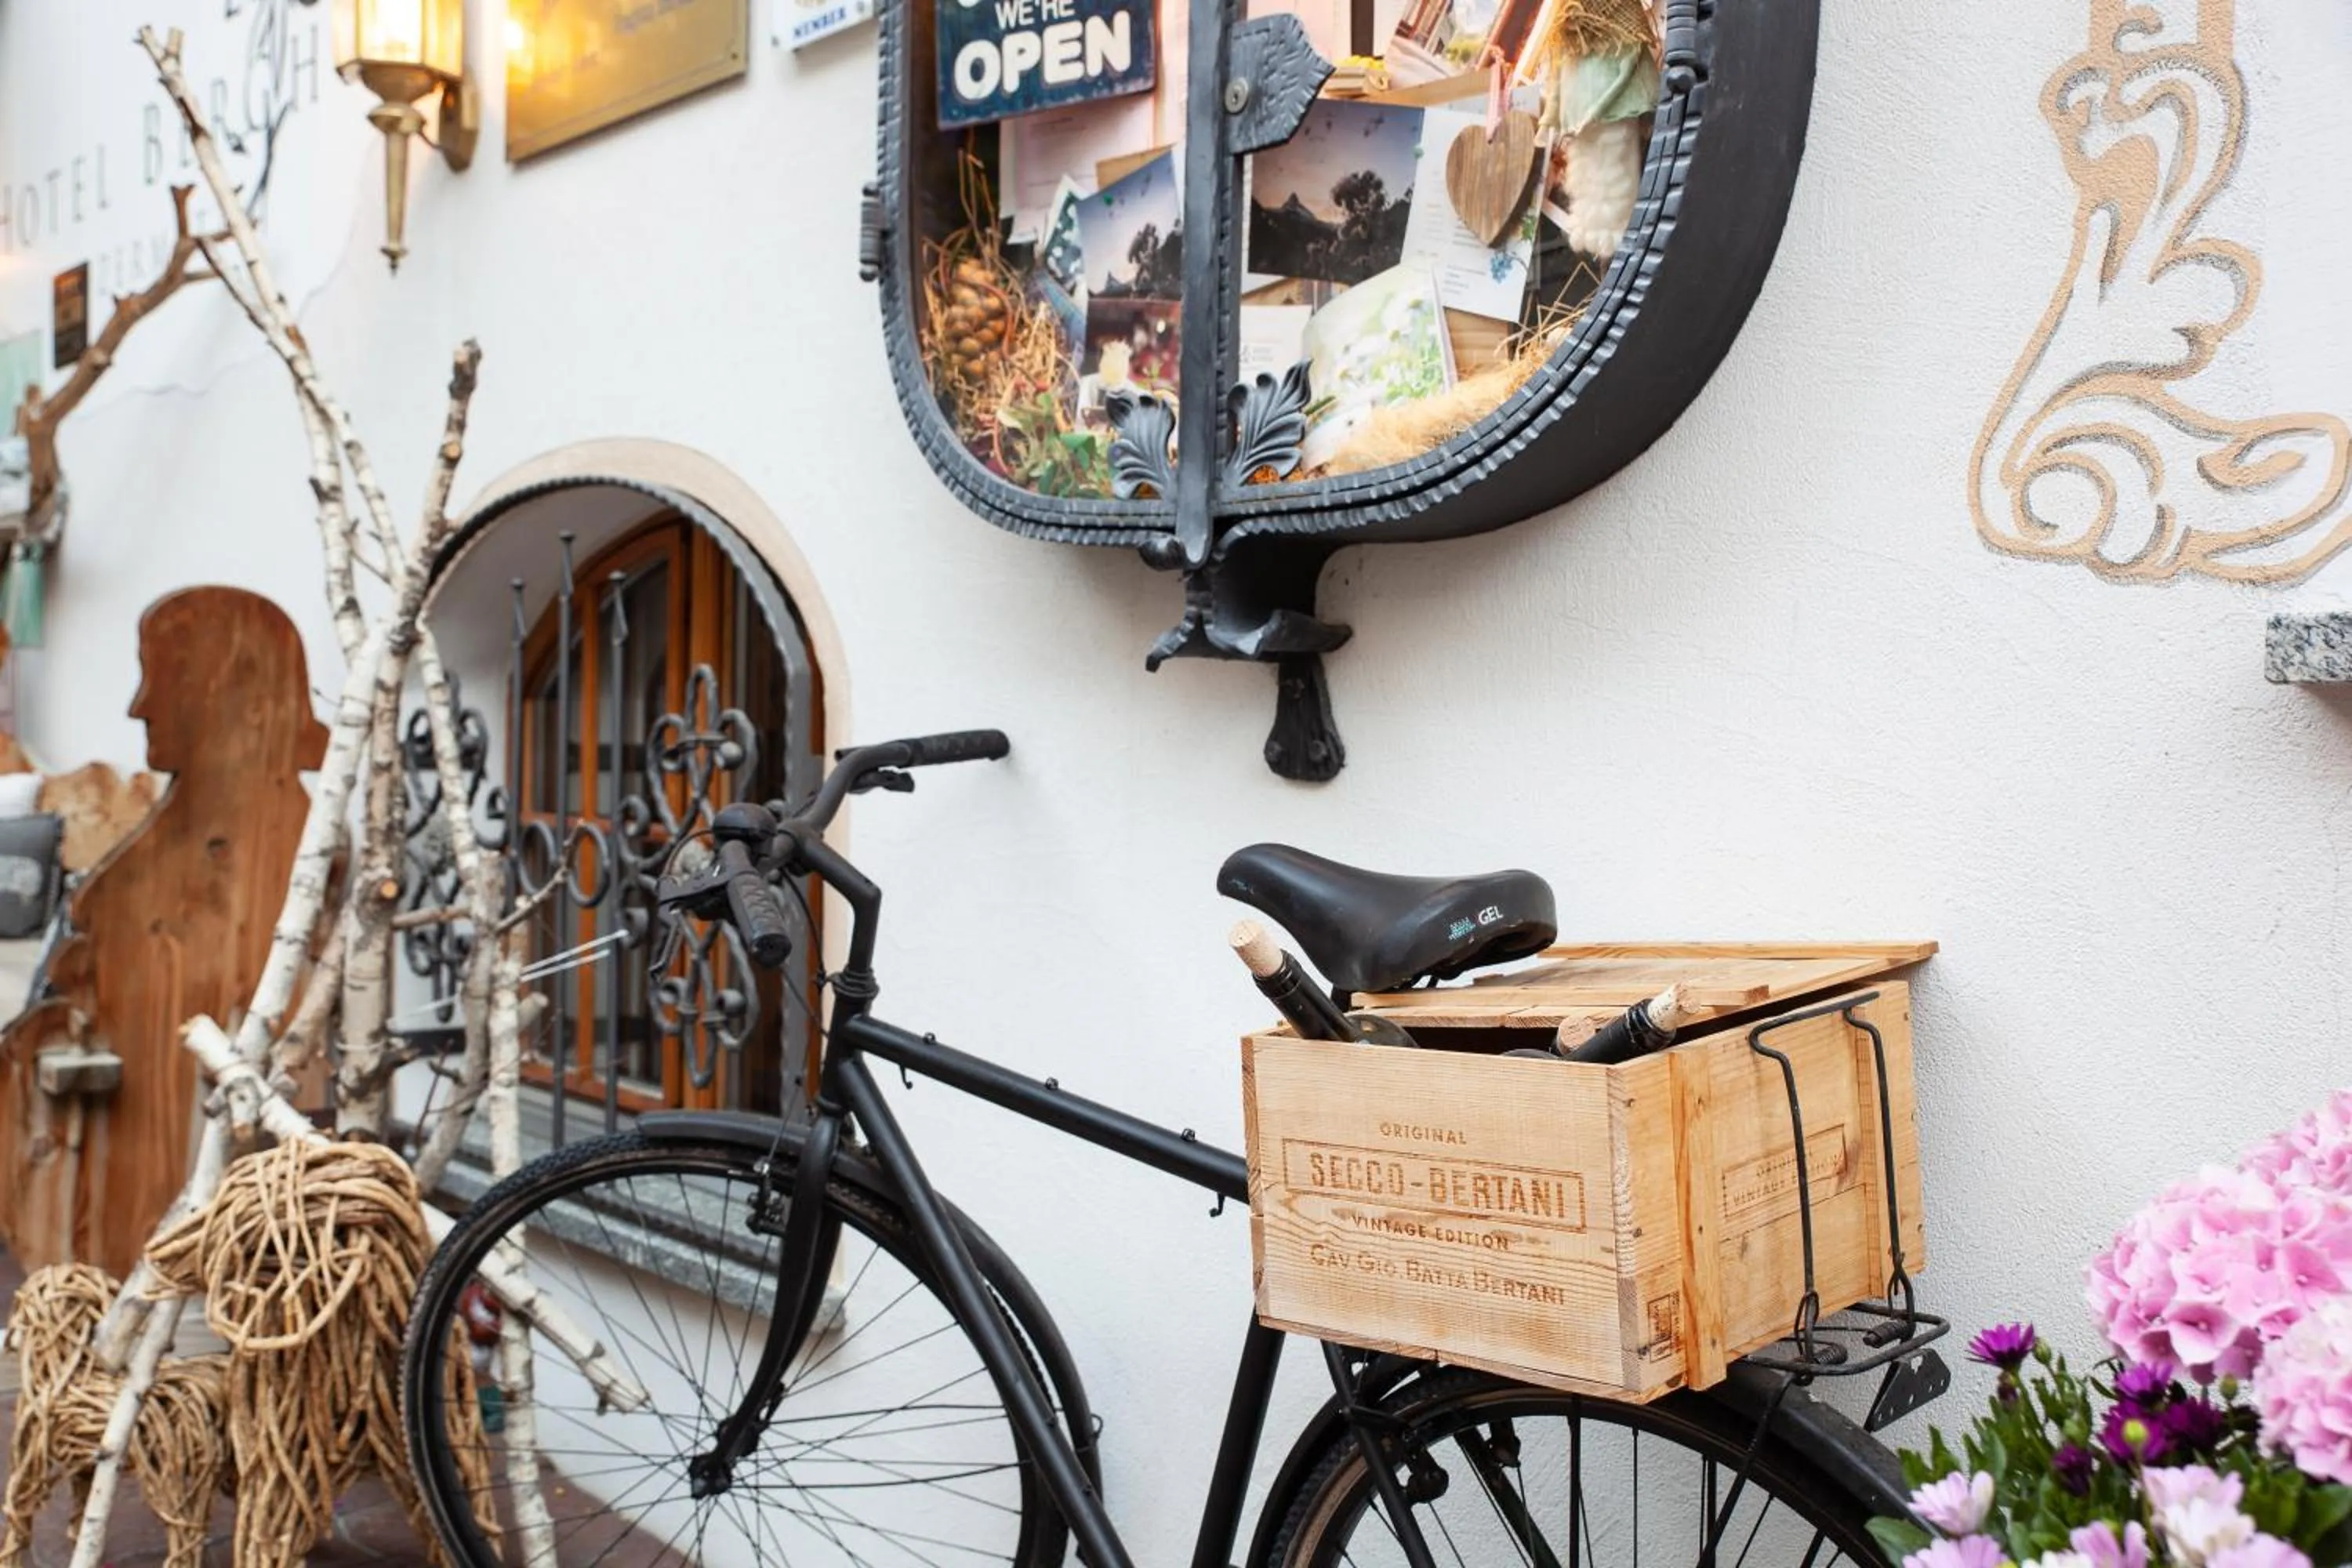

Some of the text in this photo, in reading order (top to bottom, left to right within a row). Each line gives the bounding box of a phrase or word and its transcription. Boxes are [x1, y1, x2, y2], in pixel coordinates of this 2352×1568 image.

[994, 0, 1076, 30] WE'RE
[954, 10, 1131, 100] OPEN
[0, 143, 109, 256] HOTEL
[1478, 906, 1504, 926] GEL
[1380, 1122, 1467, 1145] ORIGINAL
[1352, 1214, 1509, 1250] VINTAGE EDITION
